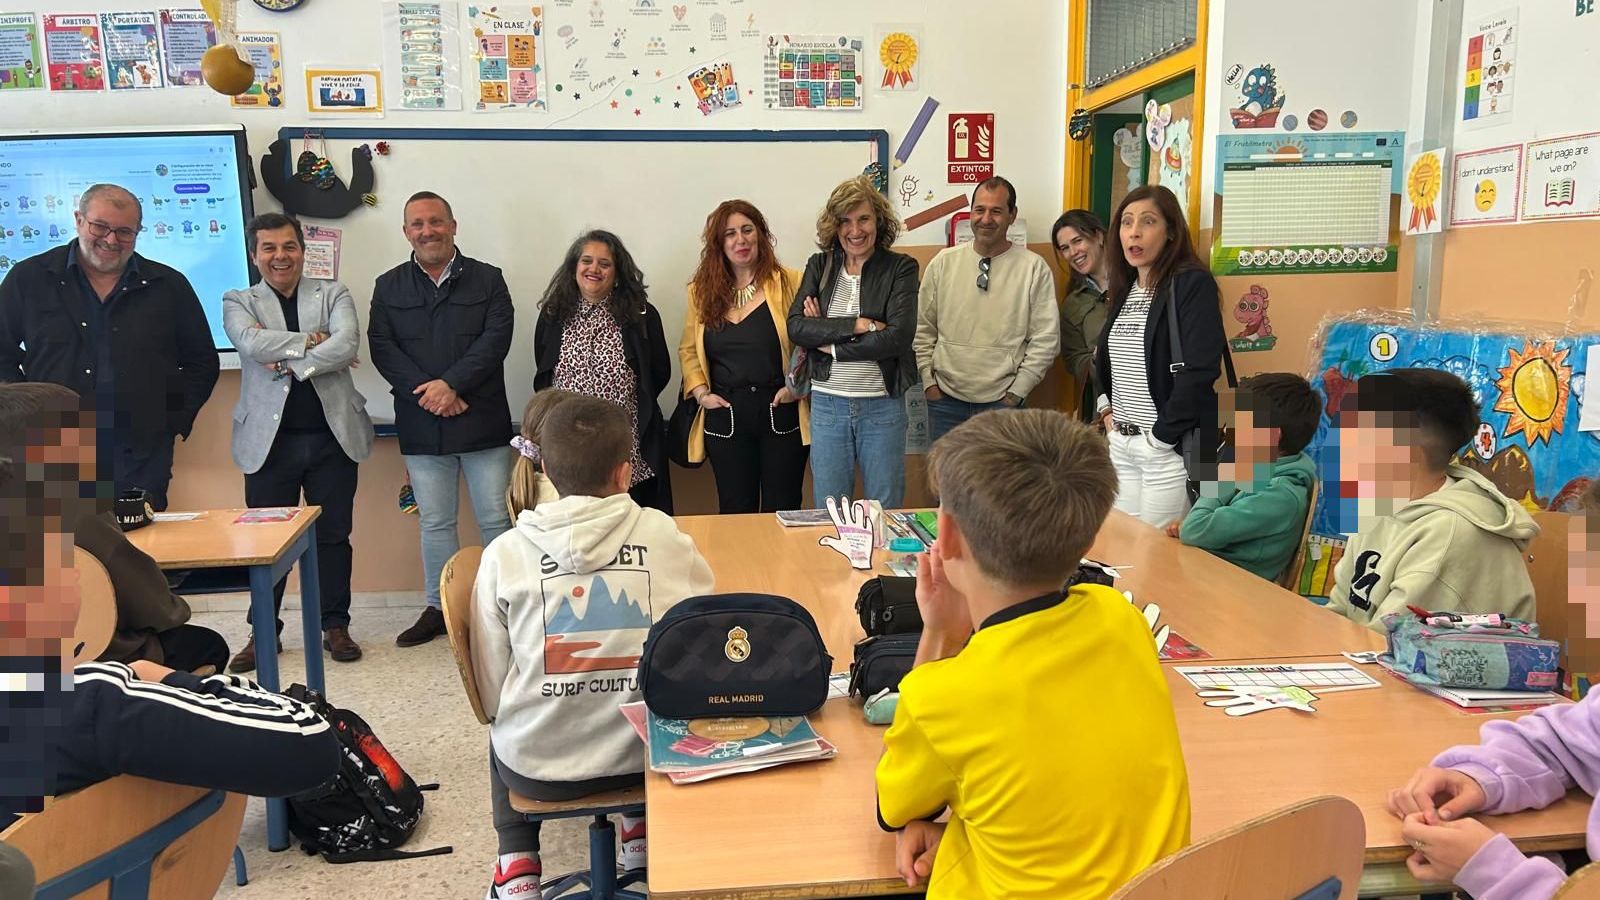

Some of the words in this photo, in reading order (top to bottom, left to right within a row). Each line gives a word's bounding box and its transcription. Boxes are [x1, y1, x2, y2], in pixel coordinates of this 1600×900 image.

[62, 17, 91, 25] ÁRBITRO
[493, 21, 503, 29] EN
[504, 21, 525, 29] CLASE
[1535, 150, 1553, 160] What
[1554, 148, 1573, 160] page
[1575, 146, 1588, 155] are
[950, 165, 990, 173] EXTINTOR
[1549, 165, 1561, 173] we
[1563, 161, 1576, 171] on?
[1377, 337, 1390, 356] 1
[541, 681, 586, 698] SURF
[589, 677, 642, 693] CULTU
[708, 696, 730, 704] REAL
[731, 694, 764, 703] MADRID
[507, 882, 538, 896] adidas
